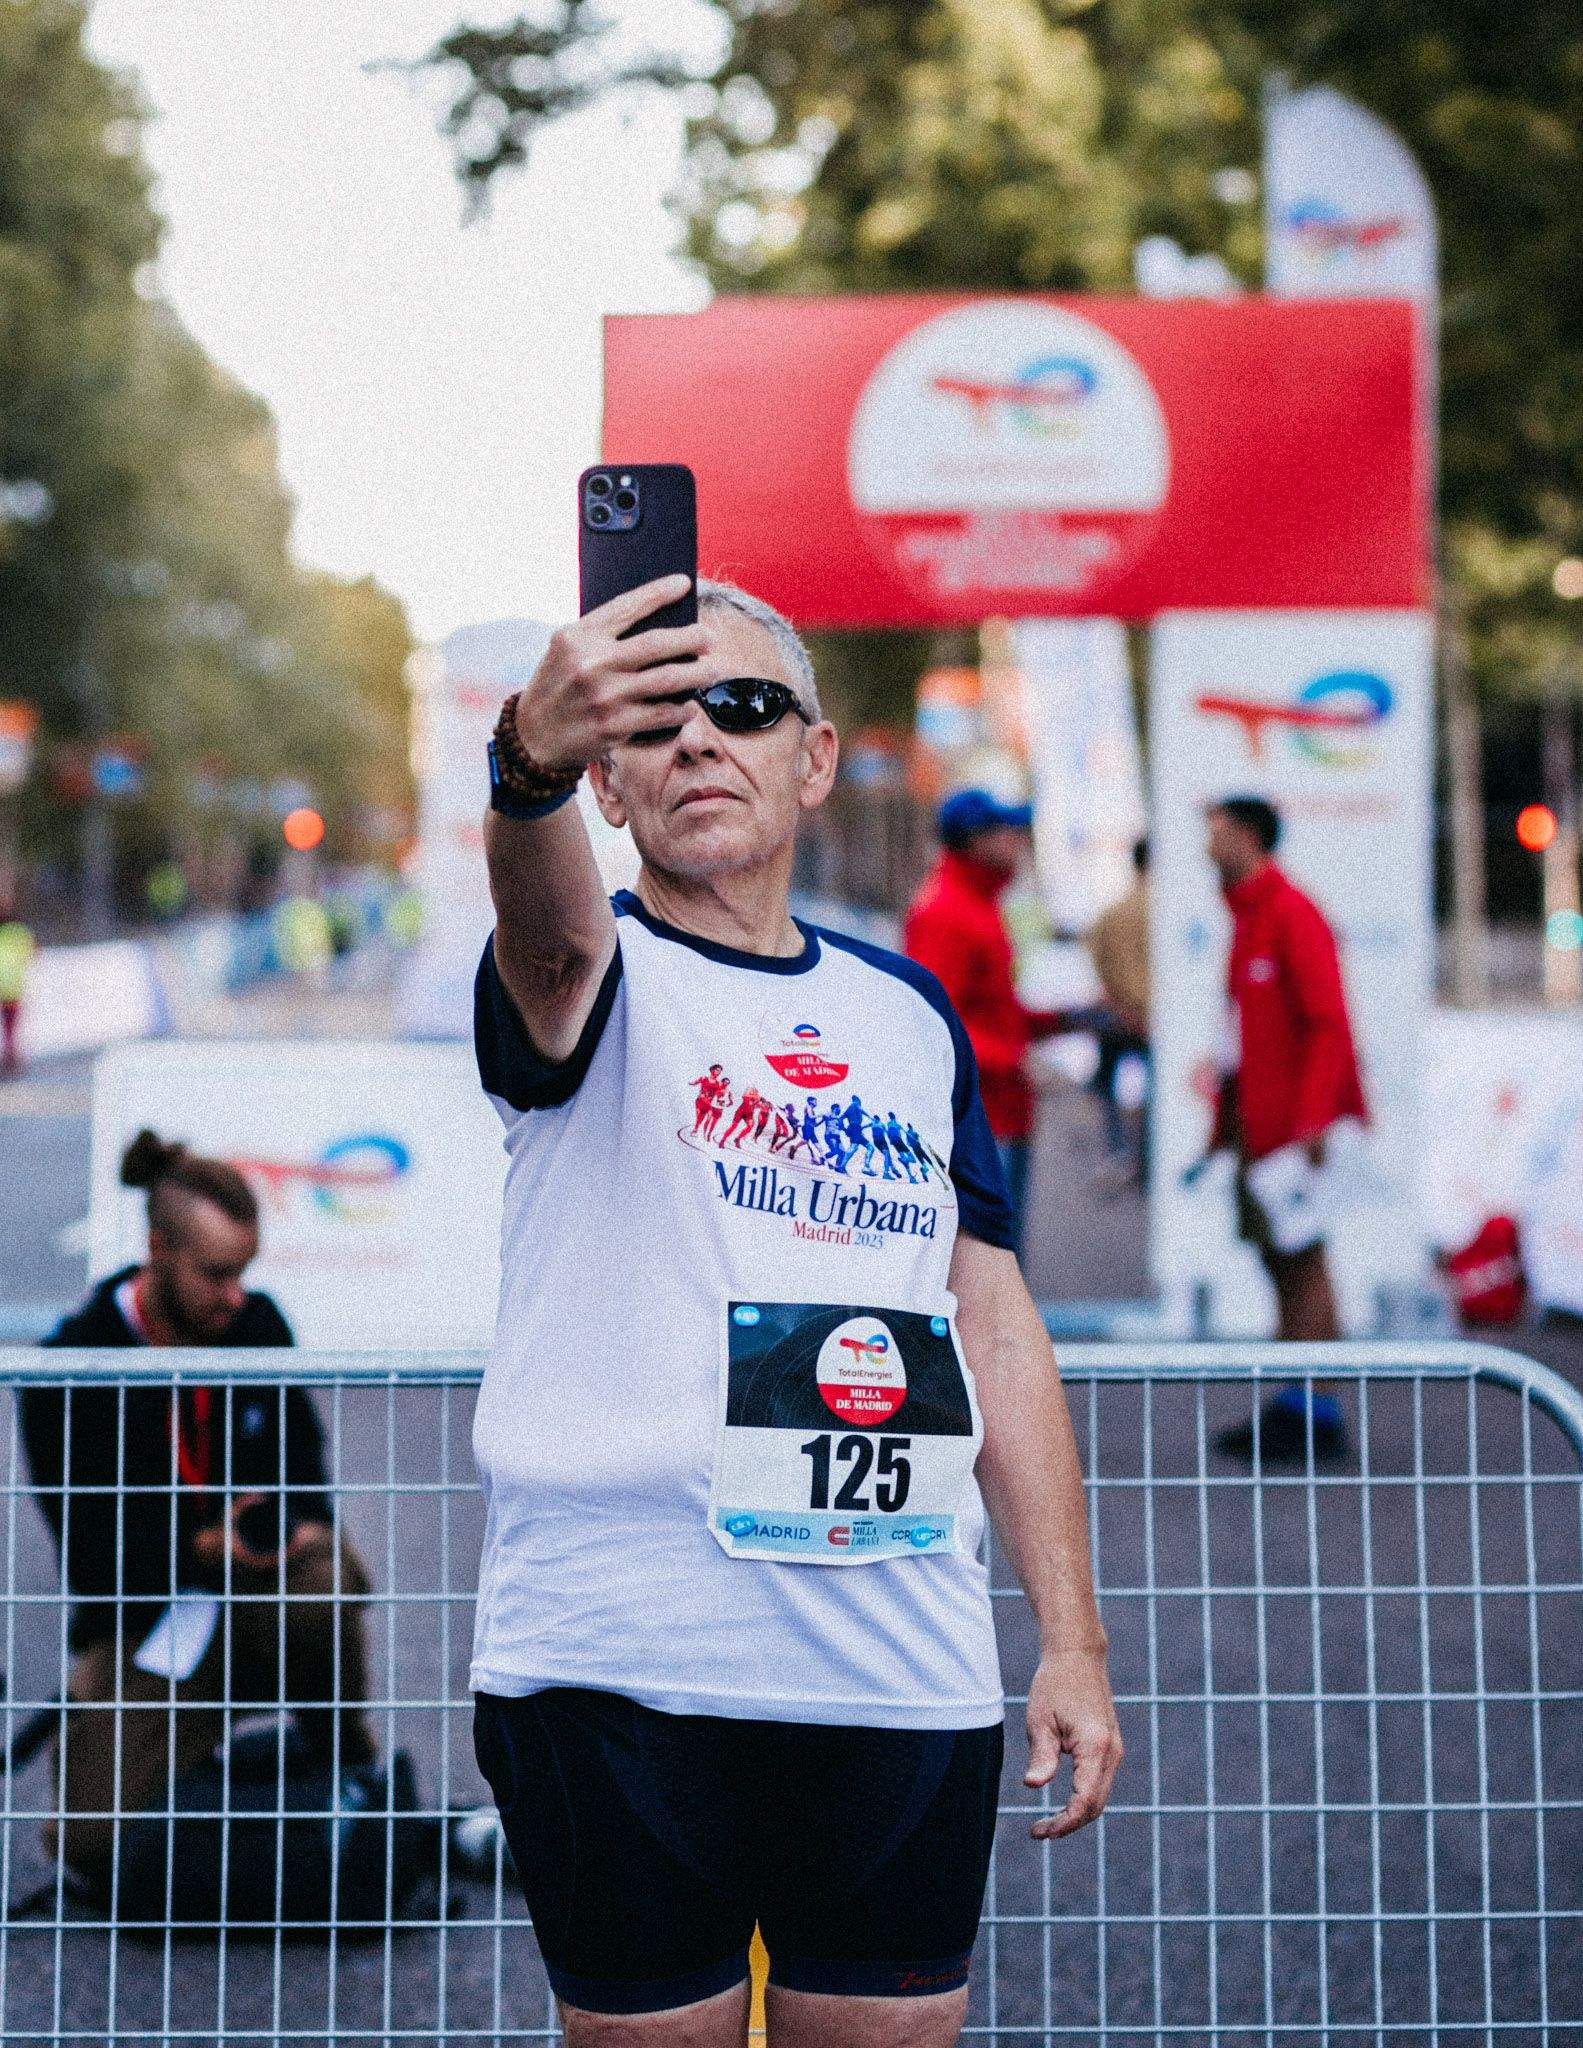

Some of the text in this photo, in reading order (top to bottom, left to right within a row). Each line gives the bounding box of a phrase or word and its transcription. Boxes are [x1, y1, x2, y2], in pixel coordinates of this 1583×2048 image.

[713, 1161, 938, 1239] Milla Urbana
[791, 1221, 883, 1248] Madrid 2023
[838, 1368, 893, 1380] TotalEnergies
[850, 1387, 881, 1399] MILLA
[835, 1399, 893, 1412] DE MADRID
[800, 1434, 911, 1513] 125
